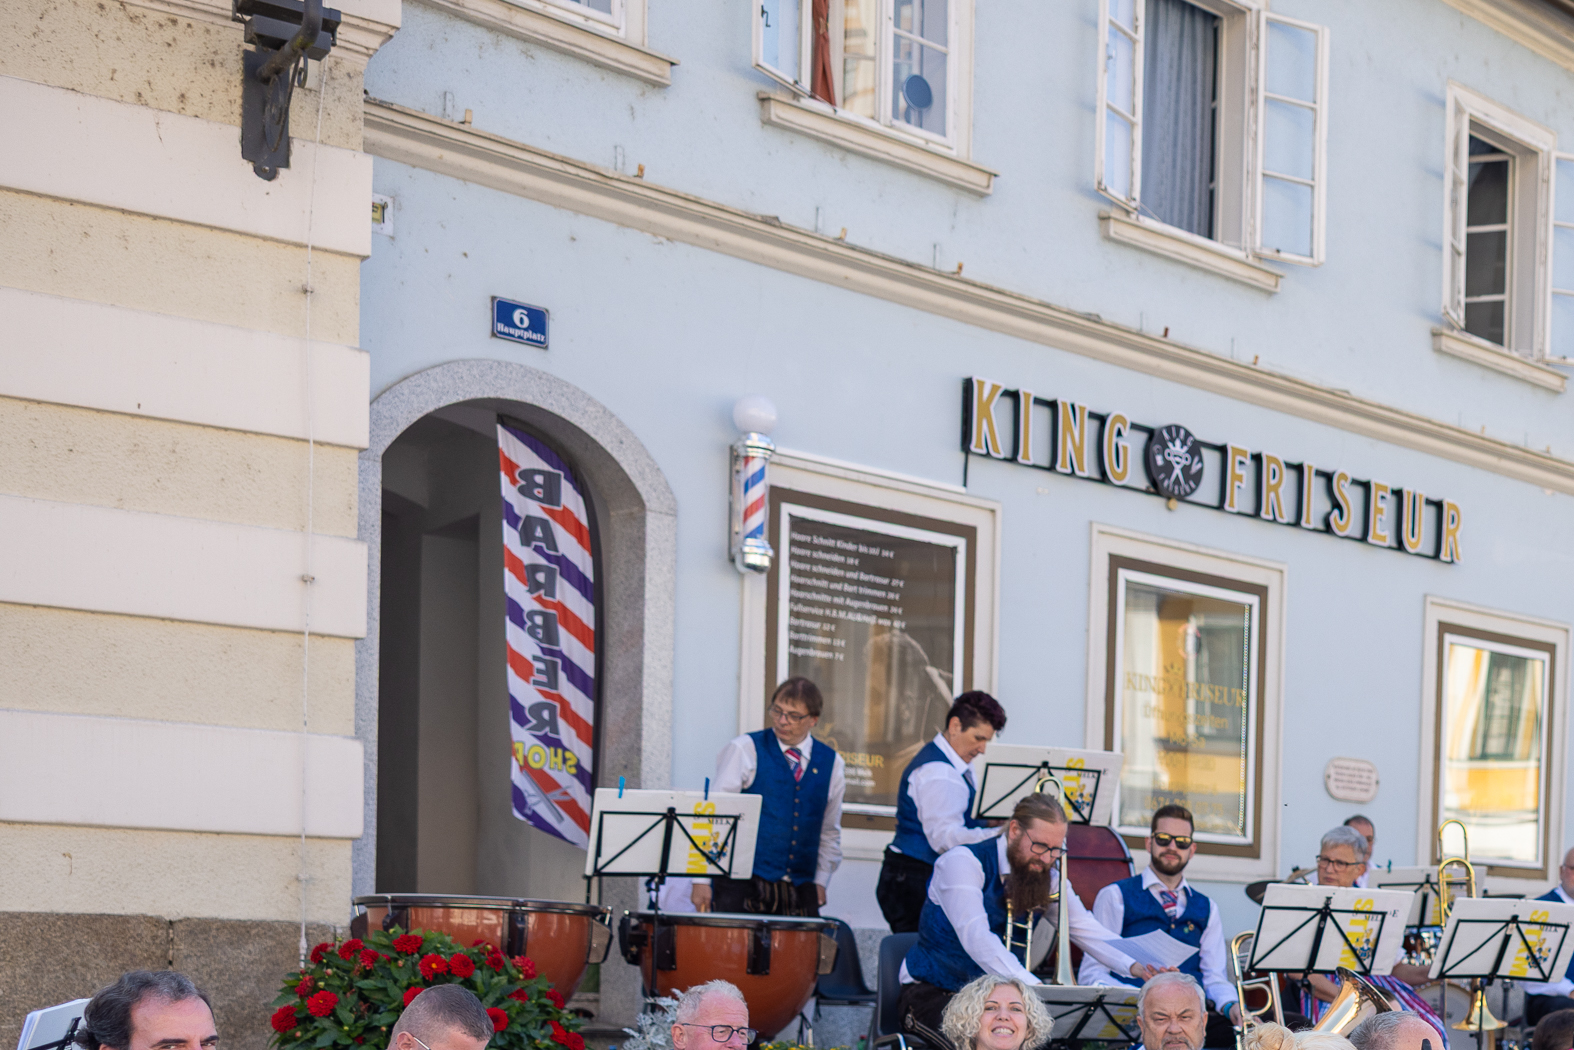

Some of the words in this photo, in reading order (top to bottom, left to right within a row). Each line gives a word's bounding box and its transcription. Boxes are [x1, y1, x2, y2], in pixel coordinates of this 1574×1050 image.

[513, 308, 530, 329] 6
[497, 321, 545, 342] Hauptplatz
[969, 376, 1132, 486] KING
[1224, 443, 1463, 564] FRISEUR
